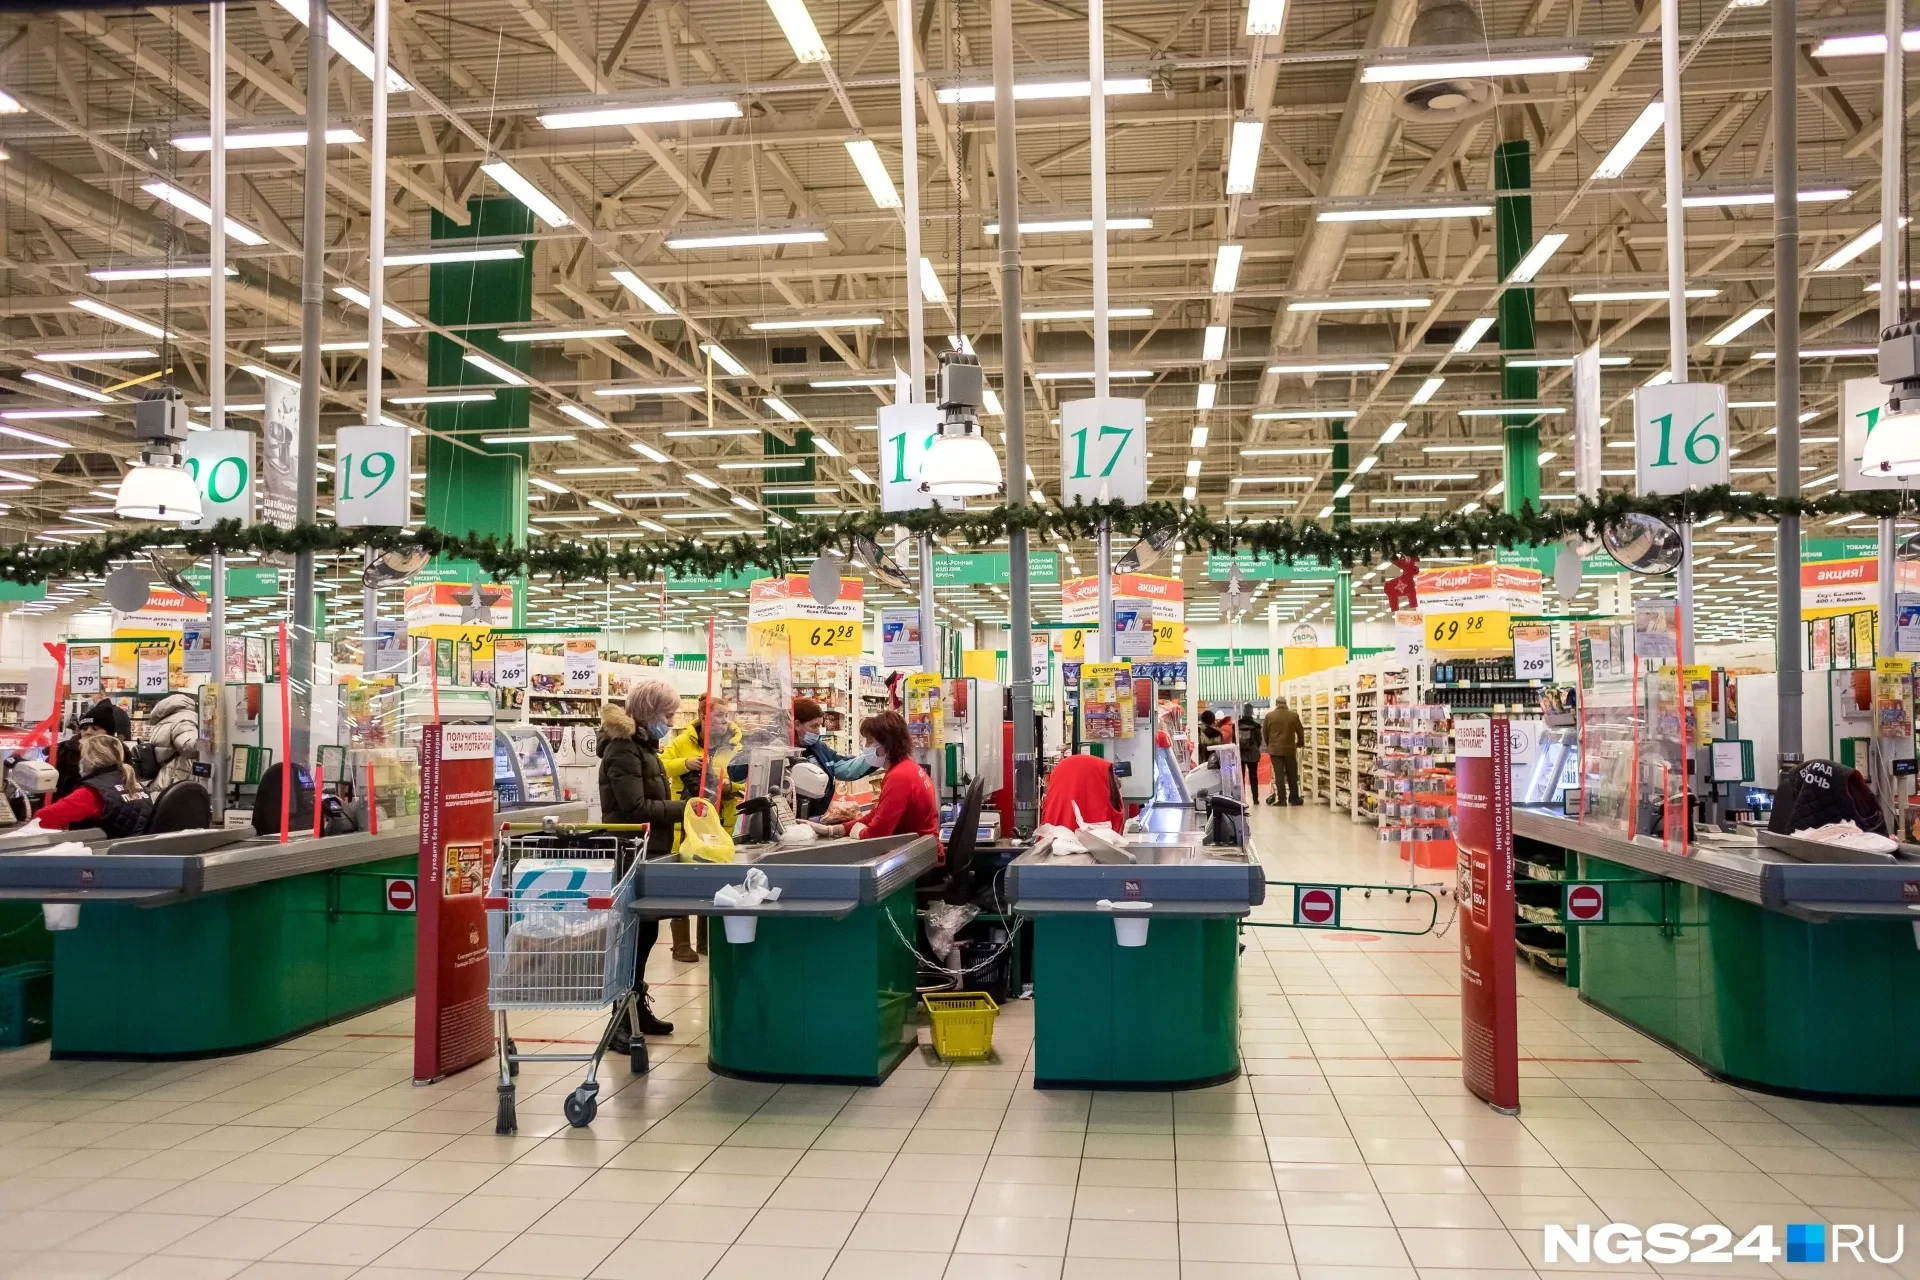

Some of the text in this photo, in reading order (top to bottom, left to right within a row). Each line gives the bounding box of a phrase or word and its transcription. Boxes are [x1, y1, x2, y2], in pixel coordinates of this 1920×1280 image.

[1650, 412, 1720, 467] 16
[1069, 425, 1134, 479] 17
[339, 452, 396, 501] 19
[263, 498, 297, 513] ШВЕЙЦАРСК
[1818, 566, 1864, 580] акция!
[1436, 574, 1472, 587] акция!
[1138, 583, 1168, 594] акция!
[1160, 626, 1172, 638] 00
[1434, 616, 1484, 641] 69 98
[810, 626, 854, 646] 62 98
[1408, 645, 1418, 654] 29
[1523, 660, 1544, 670] 269
[502, 670, 520, 678] 269
[572, 670, 590, 680] 269
[78, 676, 94, 686] 579
[146, 678, 162, 686] 219
[446, 732, 478, 742] ПОЛУЧИТЕ
[424, 730, 432, 765] КУПИТЬ?
[450, 742, 464, 752] ЧЕМ
[1494, 765, 1502, 801] ЗАБЫЛИ
[1805, 774, 1830, 789] ОЧЬ
[424, 800, 430, 812] НЕ
[1495, 802, 1502, 814] НЕ
[422, 812, 430, 844] НИЧЕГО
[430, 872, 436, 882] Не
[1506, 880, 1512, 890] Не
